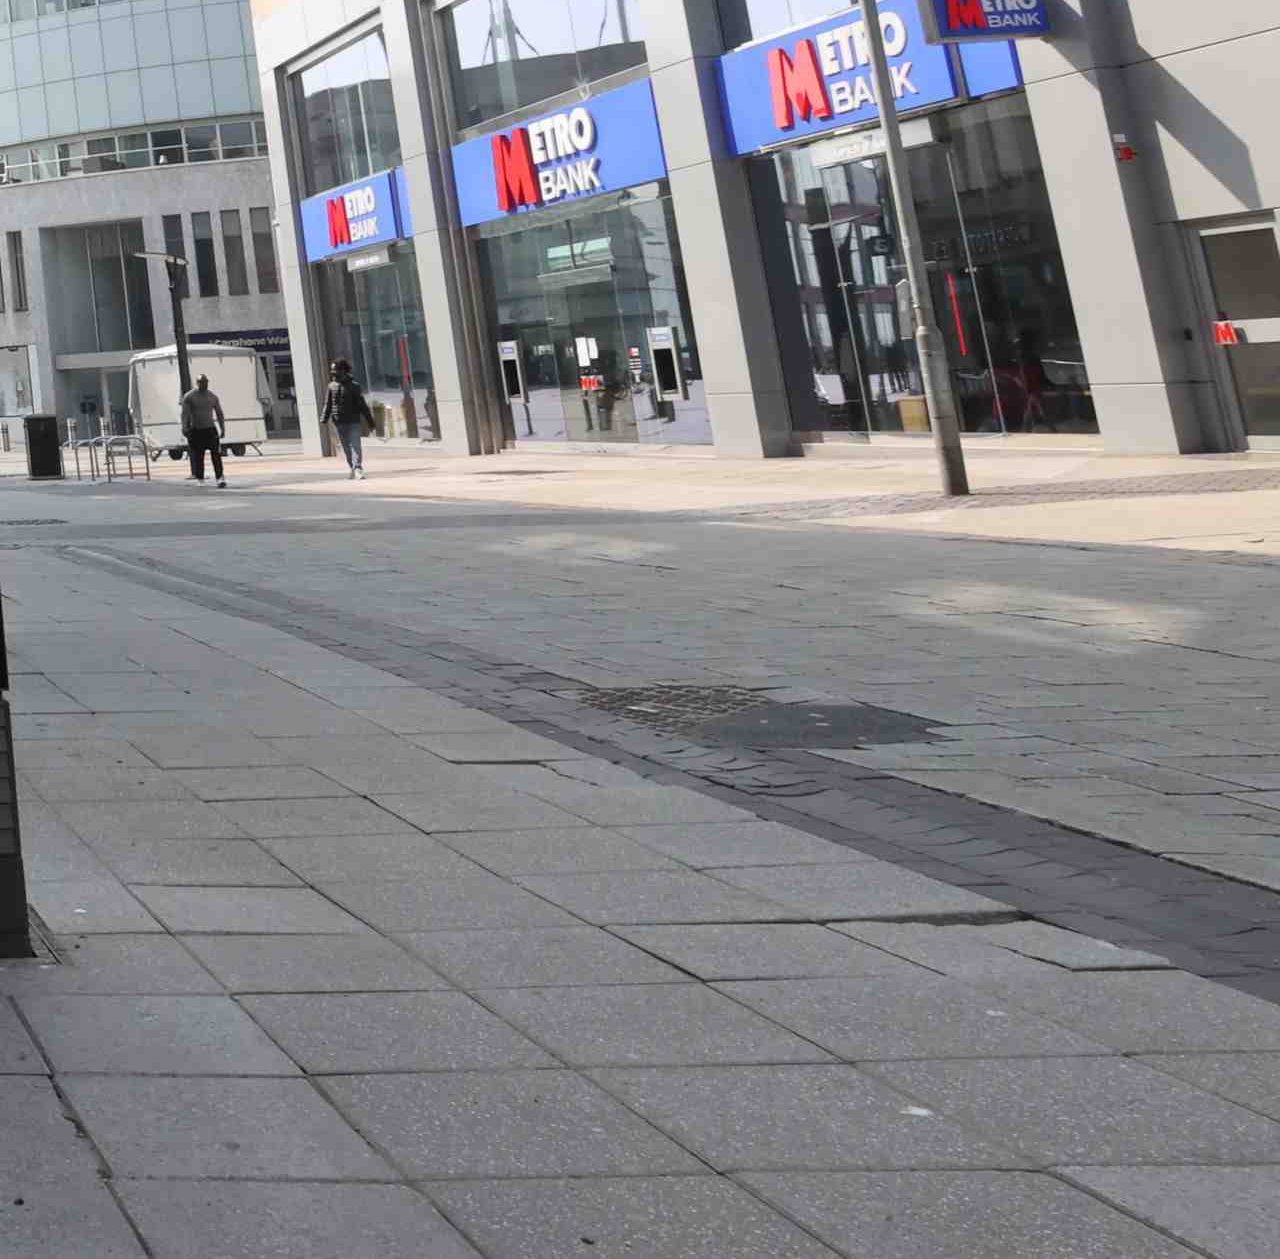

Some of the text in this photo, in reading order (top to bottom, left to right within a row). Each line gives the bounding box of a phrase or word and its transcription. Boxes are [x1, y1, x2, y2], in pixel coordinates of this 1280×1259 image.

[988, 12, 1041, 28] BANK
[493, 107, 595, 211] METRO
[539, 157, 600, 202] BANK
[327, 187, 376, 246] METRO
[350, 217, 379, 242] BANK
